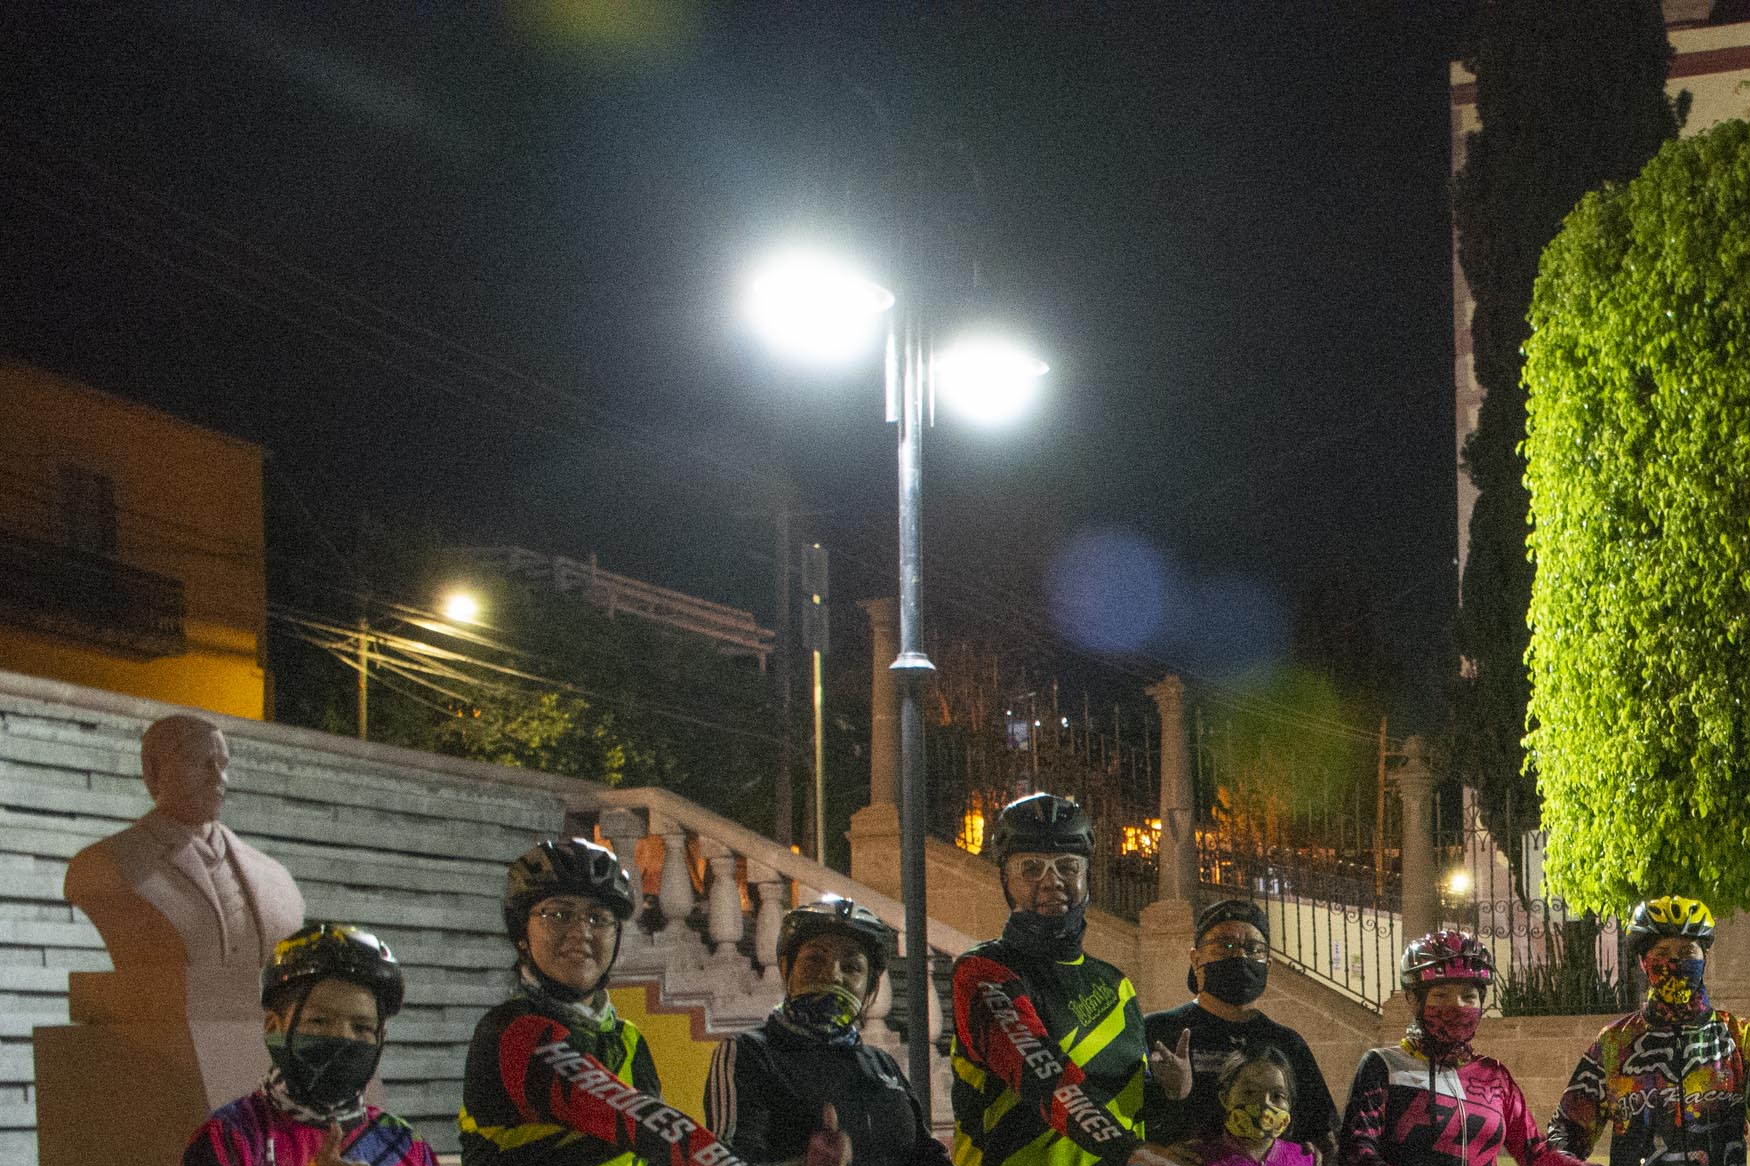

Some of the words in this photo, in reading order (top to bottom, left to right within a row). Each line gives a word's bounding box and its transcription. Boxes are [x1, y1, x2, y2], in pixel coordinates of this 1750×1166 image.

[535, 1041, 697, 1143] HERCULES
[978, 981, 1064, 1080] HERCULES
[1053, 1083, 1123, 1142] BIKES
